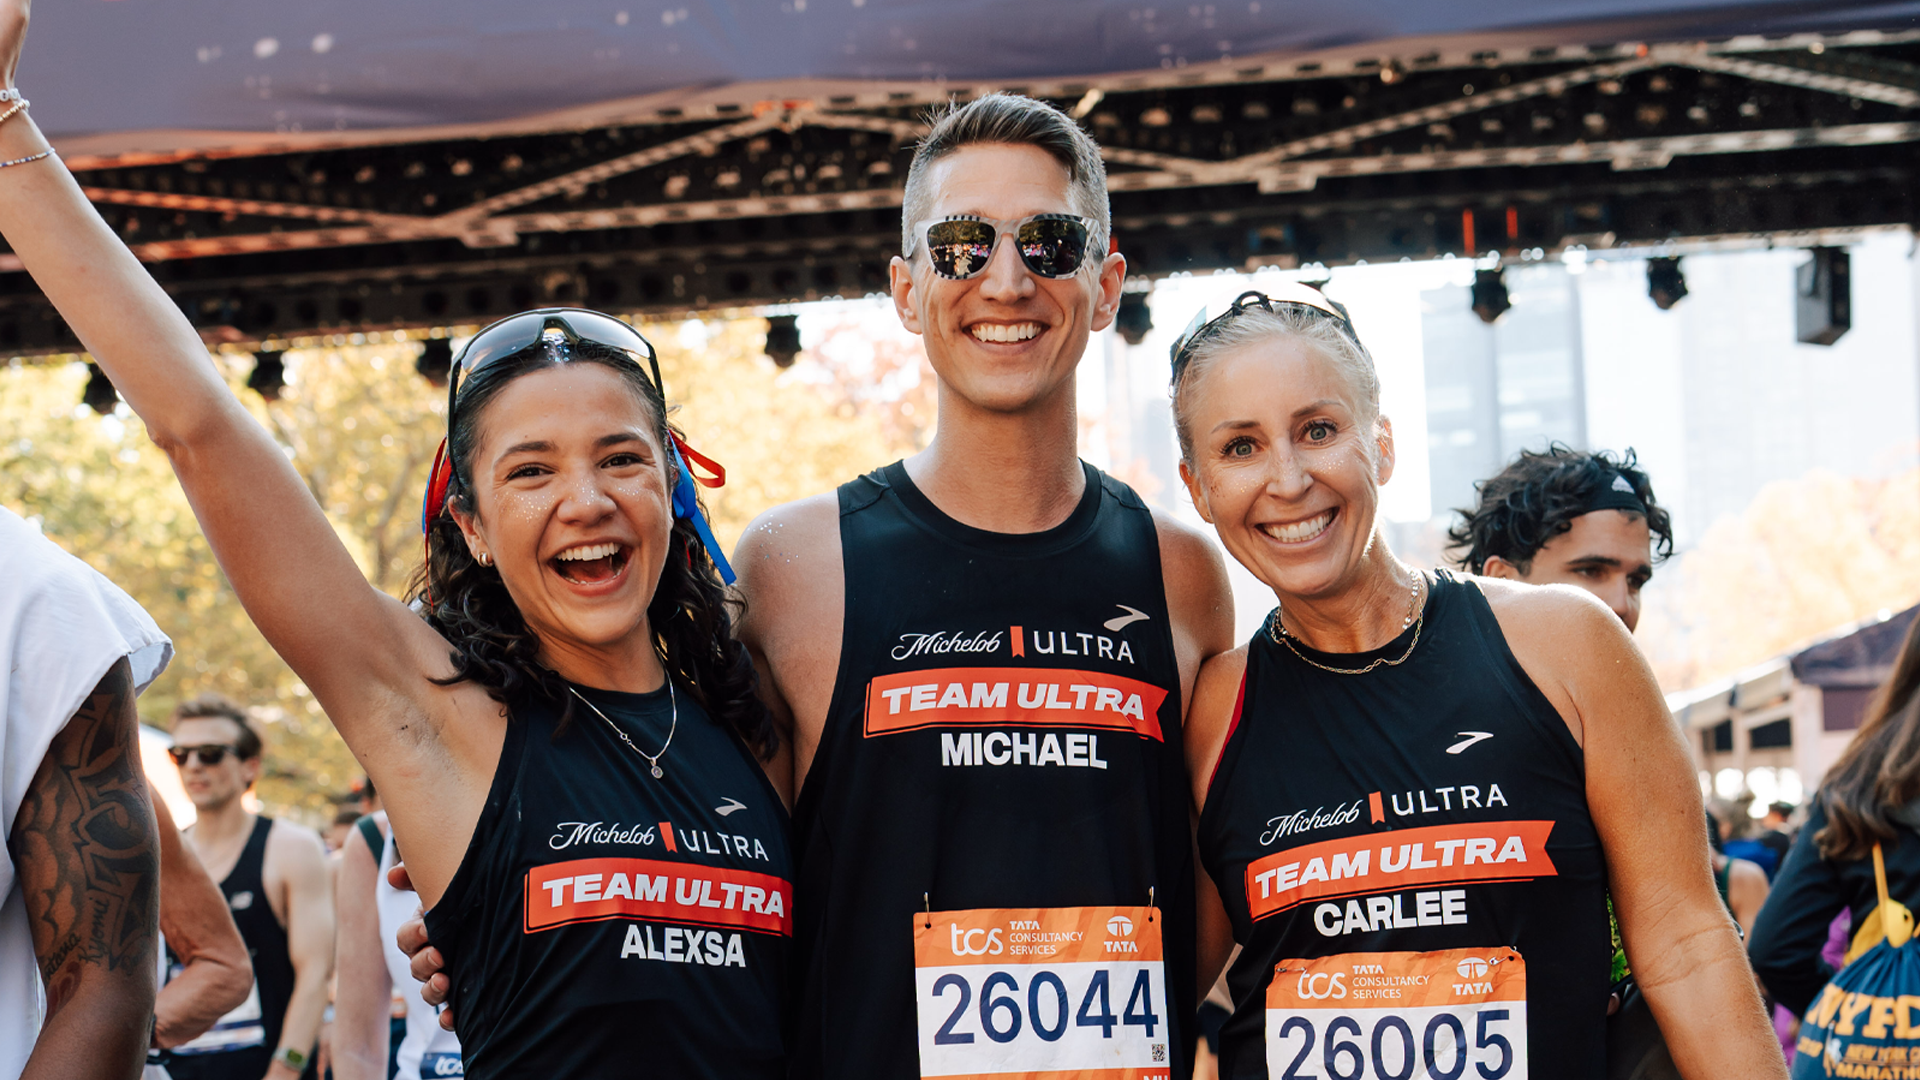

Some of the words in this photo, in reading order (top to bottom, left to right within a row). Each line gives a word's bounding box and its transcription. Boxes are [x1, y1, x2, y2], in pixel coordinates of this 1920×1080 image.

[891, 630, 1003, 660] Michelob
[1034, 630, 1135, 664] ULTRA
[881, 682, 1010, 715] TEAM
[1016, 682, 1145, 721] ULTRA
[941, 731, 1107, 770] MICHAEL
[1259, 799, 1363, 846] Michelob
[1391, 783, 1509, 817] ULTRA
[549, 821, 655, 850] Michelob
[679, 829, 770, 861] ULTRA
[1255, 849, 1371, 900] TEAM
[1379, 835, 1527, 874] ULTRA
[542, 872, 668, 908] TEAM
[674, 877, 785, 918] ULTRA
[1313, 889, 1468, 937] CARLEE
[951, 922, 1004, 956] tcs
[1009, 920, 1041, 931] TATA
[1009, 931, 1084, 943] CONSULTANCY
[620, 923, 747, 968] ALEXSA
[1009, 944, 1057, 955] SERVICES
[1104, 941, 1139, 952] TATA
[1352, 964, 1385, 975] TATA
[1352, 975, 1431, 987] CONSULTANCY
[1352, 988, 1402, 1000] SERVICES
[1452, 981, 1494, 996] TATA
[931, 968, 1159, 1046] 26044
[1279, 1009, 1514, 1080] 26005
